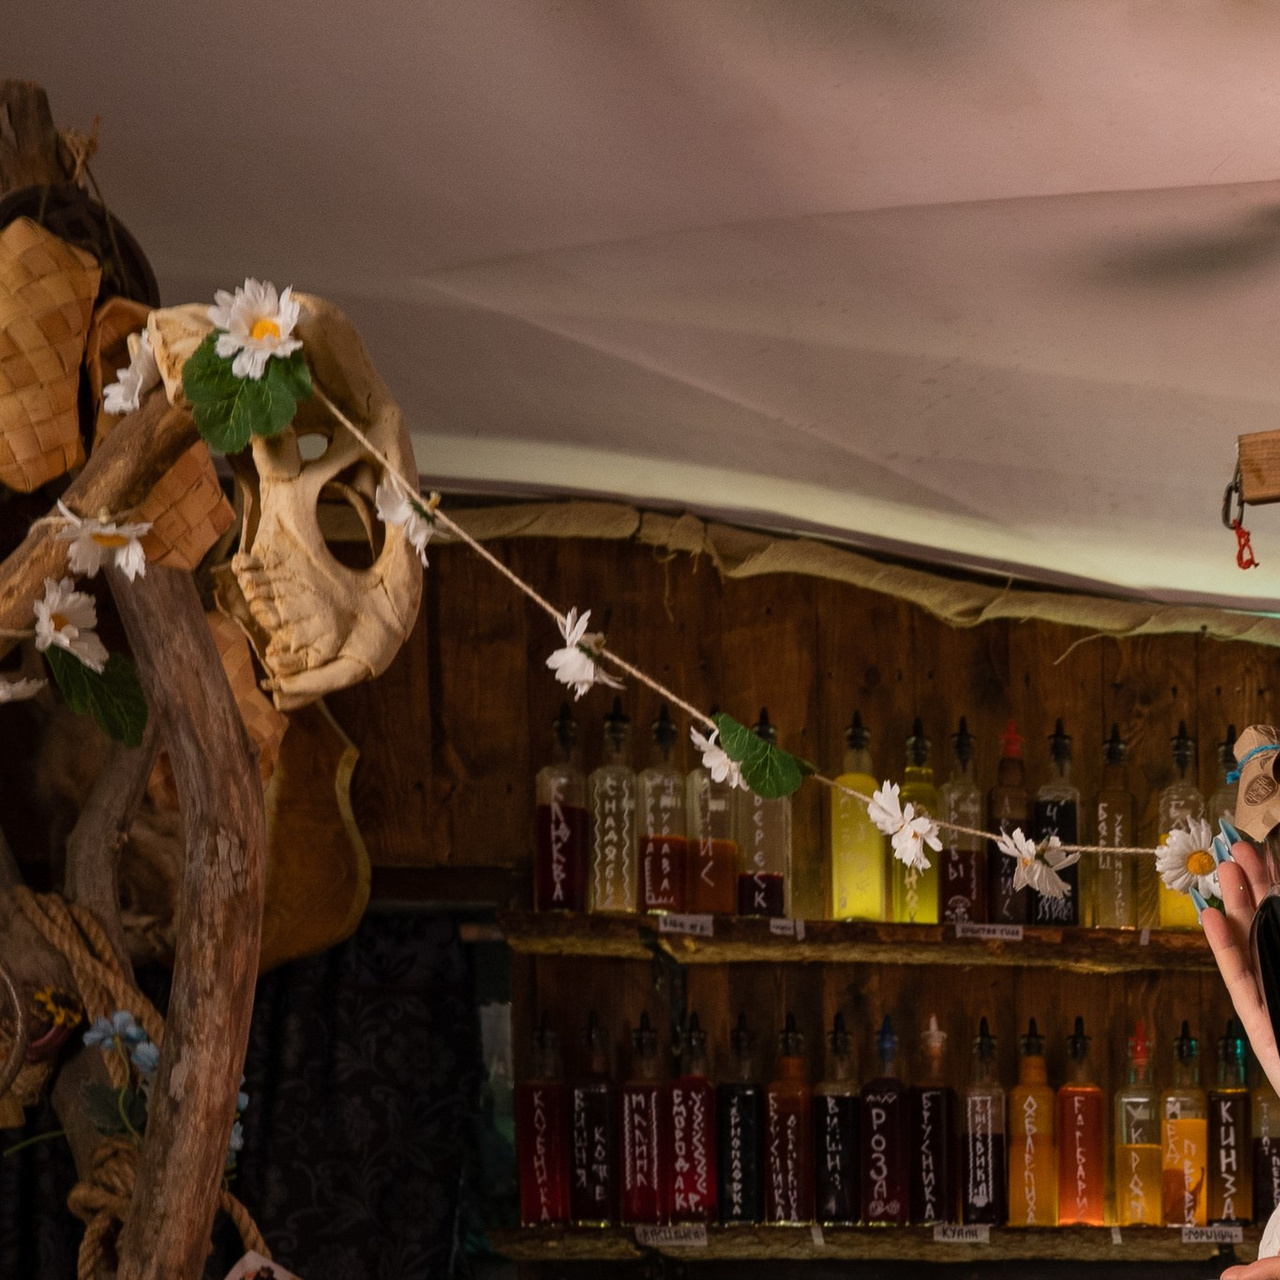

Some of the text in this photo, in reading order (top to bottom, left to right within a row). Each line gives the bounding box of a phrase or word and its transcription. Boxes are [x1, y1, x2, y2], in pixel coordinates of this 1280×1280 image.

[868, 1107, 888, 1200] РОЗА
[921, 1091, 941, 1219] БРУСНИКА
[1023, 1096, 1037, 1225] ОБЛЕПИХА
[1219, 1100, 1237, 1220] КИНЗА
